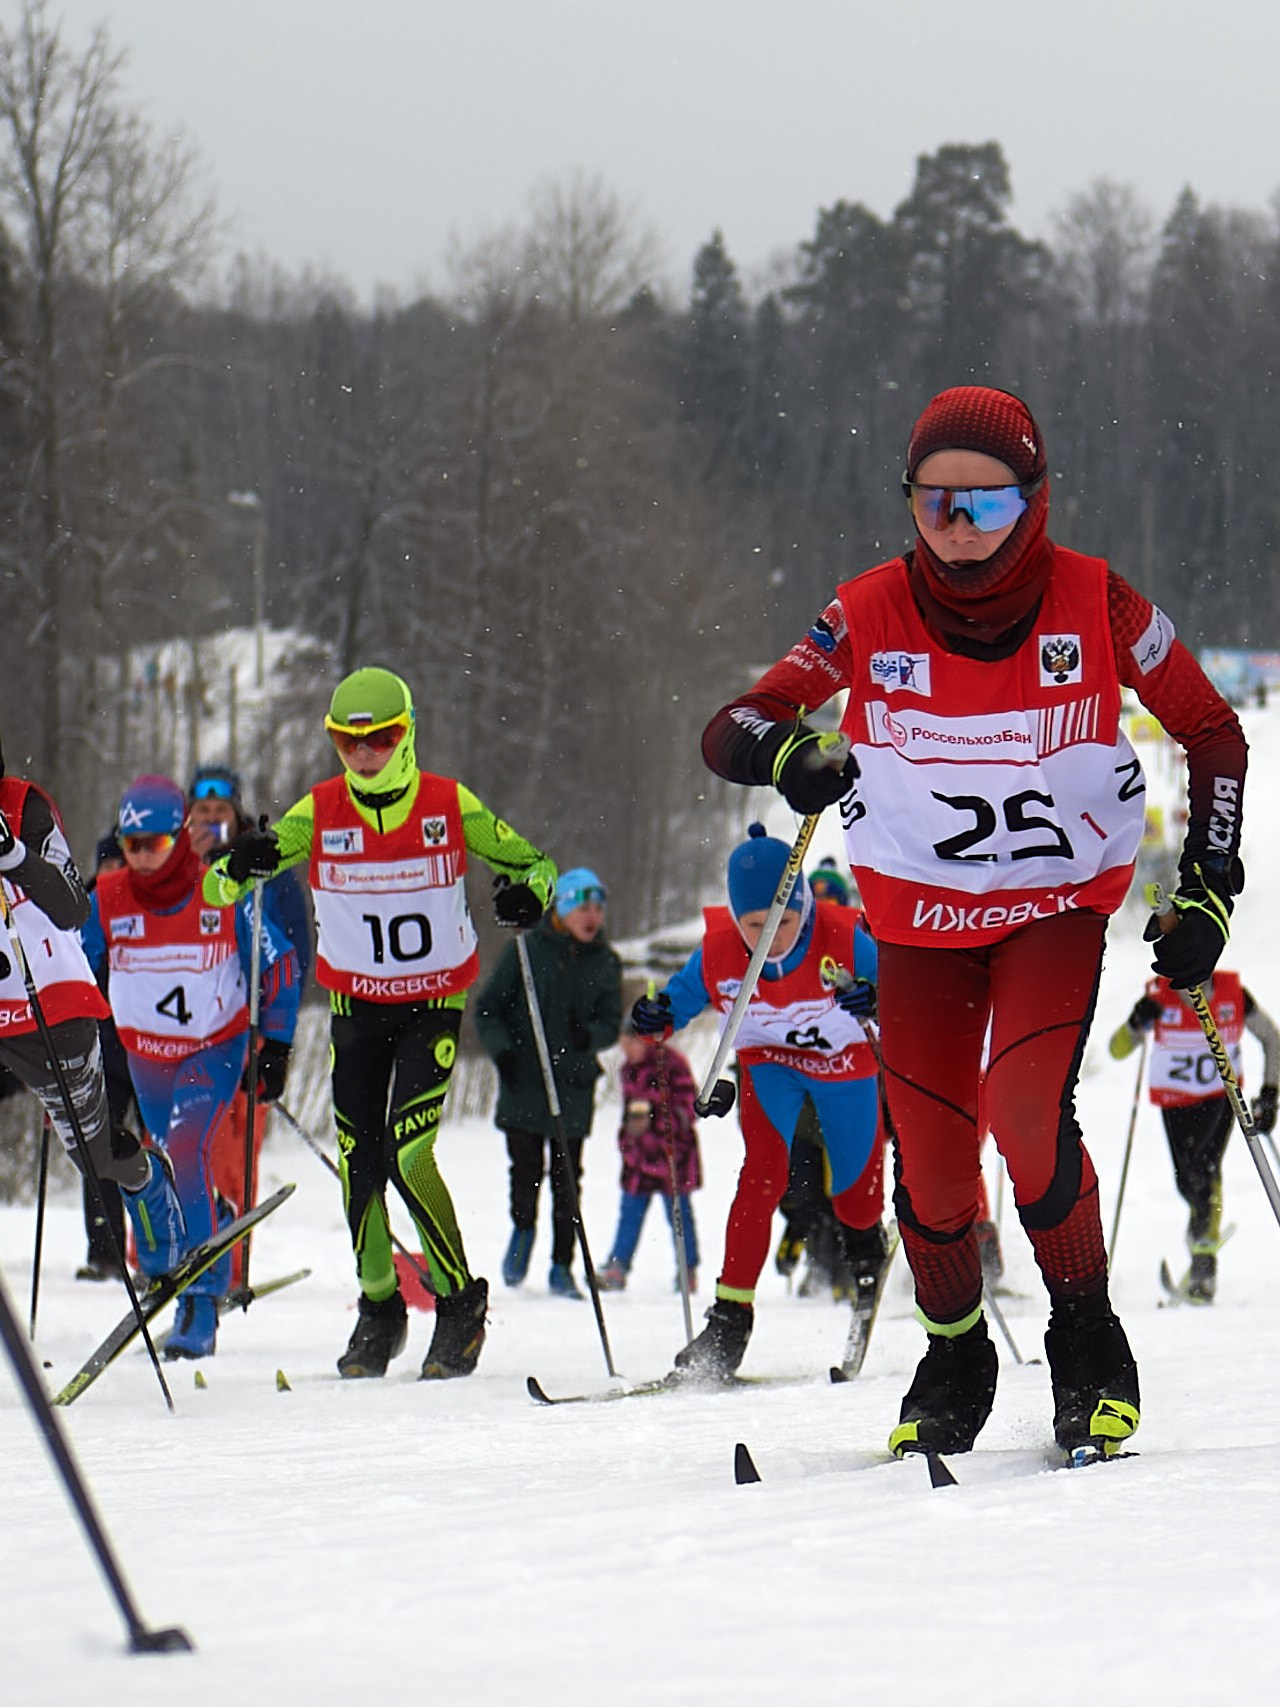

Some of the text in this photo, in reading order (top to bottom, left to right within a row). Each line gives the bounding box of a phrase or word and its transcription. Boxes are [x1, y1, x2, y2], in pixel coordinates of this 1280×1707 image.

[911, 727, 1032, 747] РоссельхозБан
[930, 789, 1075, 863] 25
[362, 913, 433, 964] 10
[156, 985, 193, 1026] 4
[1168, 1054, 1218, 1084] 20
